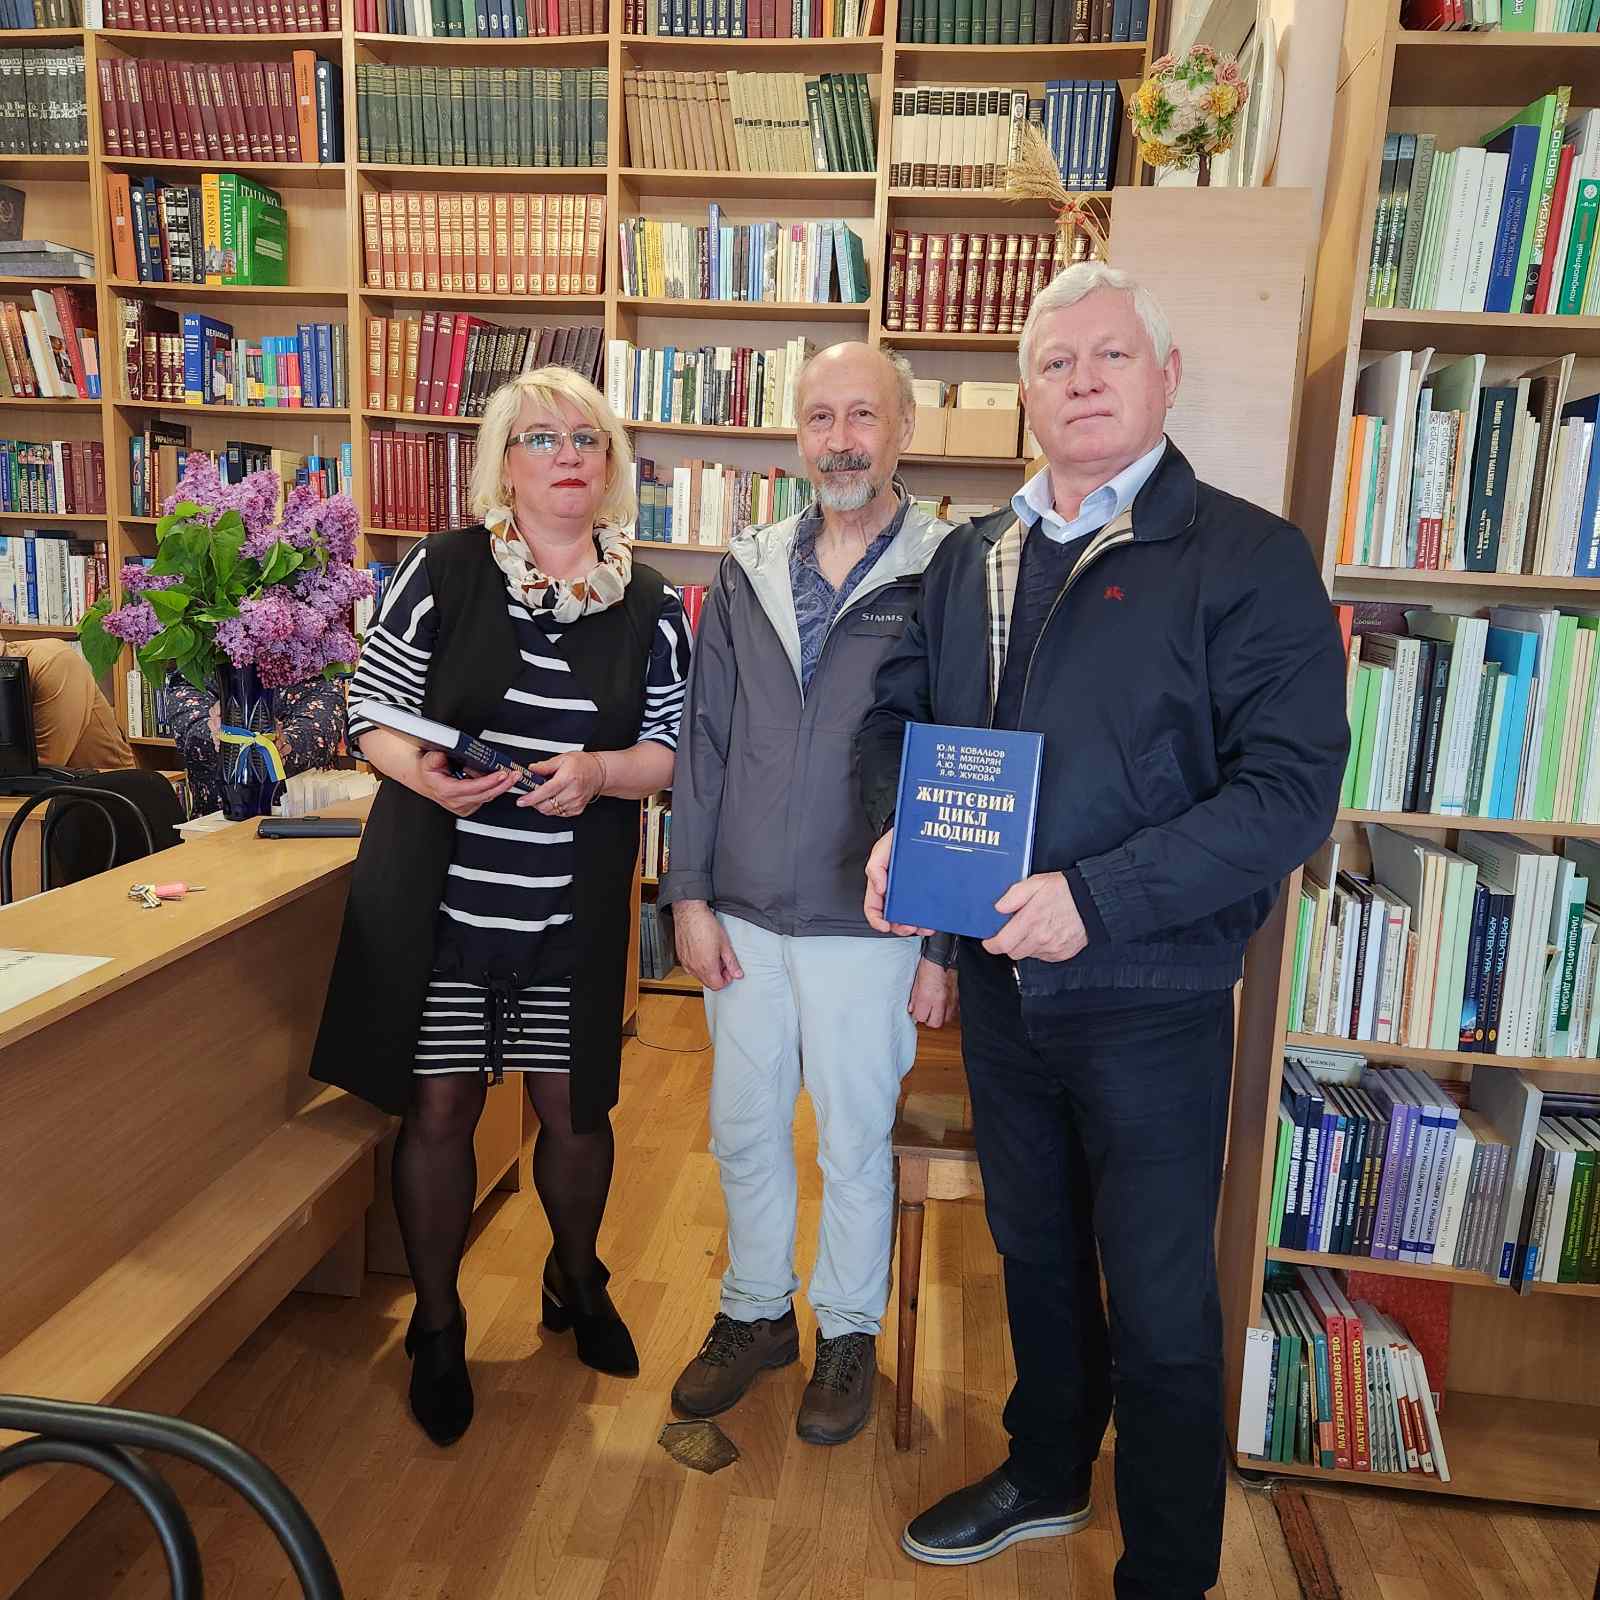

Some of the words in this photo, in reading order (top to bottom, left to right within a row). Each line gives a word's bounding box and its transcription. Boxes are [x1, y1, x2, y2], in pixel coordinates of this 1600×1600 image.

[1544, 130, 1561, 189] ОСНОВЫ
[208, 194, 217, 238] ESPAÑOL
[240, 185, 278, 207] ITALIANO
[224, 194, 232, 244] ITALIANO
[1533, 193, 1550, 258] ДИЗАЙНА
[861, 612, 903, 622] SIMMS
[936, 760, 956, 770] А.Ю.
[958, 763, 1001, 774] МОРОЗОВ
[960, 746, 1005, 758] КОВАЛЬОВ
[960, 754, 1002, 766] МХІТАРЯН
[940, 770, 957, 778] Я.Ф.
[960, 772, 995, 782] ЖУКОВА
[916, 786, 1016, 812] ЖИТТЄВИЙ
[938, 806, 988, 826] ЦИКЛ
[920, 821, 1000, 846] ЛЮДИНИ
[1483, 916, 1496, 974] АРХІТЕКТУРА
[1496, 916, 1509, 974] АРХІТЕКТУРА
[1566, 915, 1580, 981] ЛАНДШАФТНЫЙ
[1560, 982, 1571, 1016] ДИЗАЙН
[1286, 1160, 1298, 1215] ТЕХНИЧЕСКИЙ
[1292, 1126, 1304, 1160] ДИЗАЙН
[1301, 1162, 1314, 1216] ТЕХНИЧЕСКИЙ
[1308, 1127, 1320, 1161] ДИЗАЙН
[1333, 1336, 1346, 1449] МАТЕРІАЛОЗНАВСТВО
[1352, 1339, 1364, 1453] МАТЕРІАЛОЗНАВСТВО
